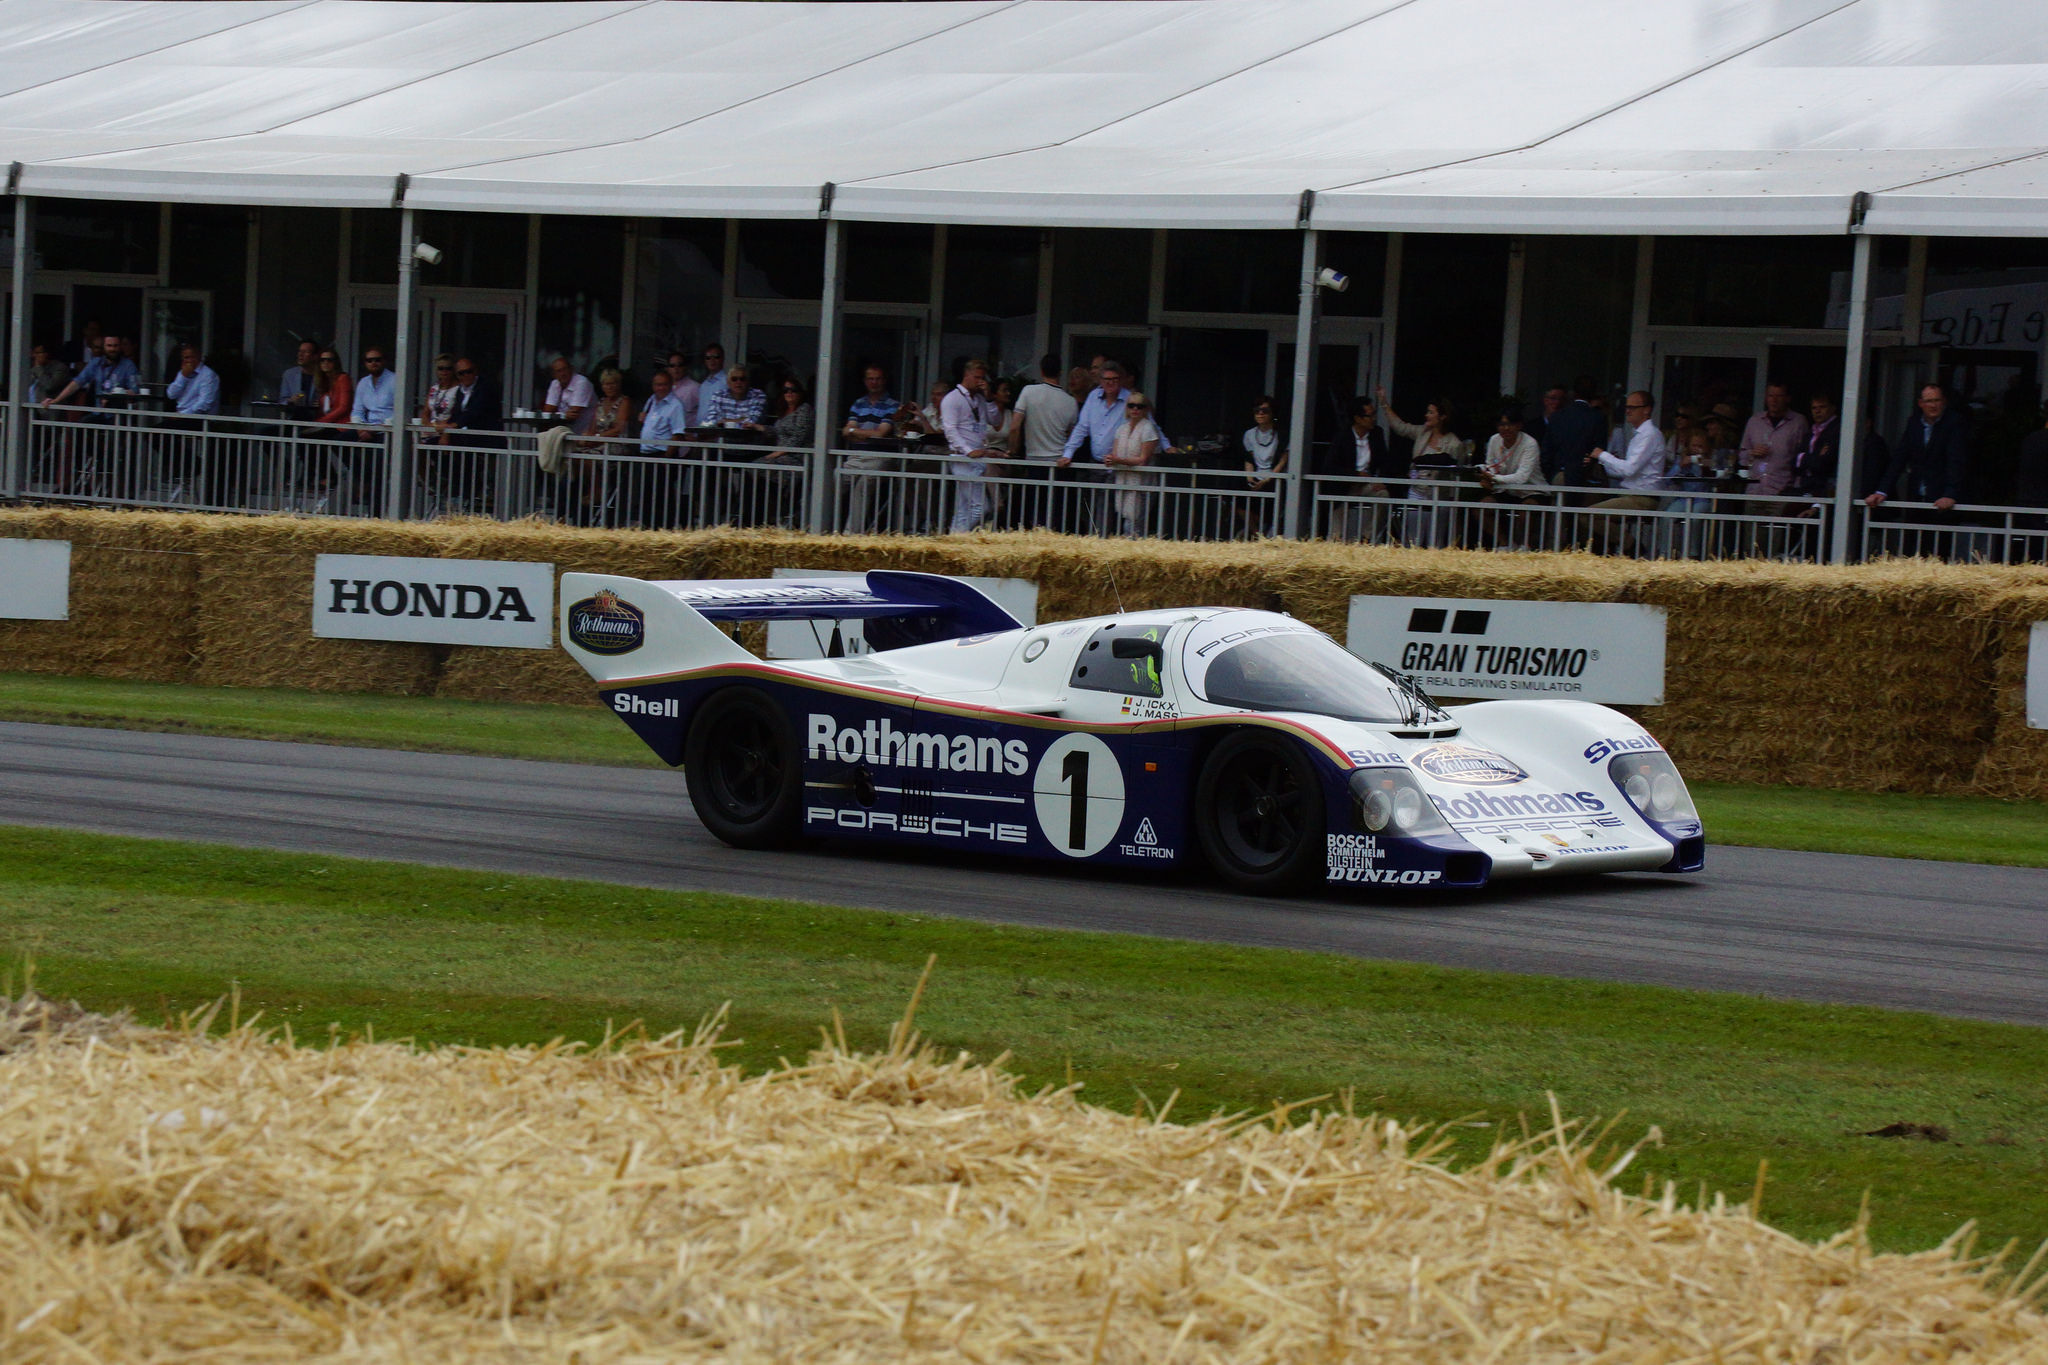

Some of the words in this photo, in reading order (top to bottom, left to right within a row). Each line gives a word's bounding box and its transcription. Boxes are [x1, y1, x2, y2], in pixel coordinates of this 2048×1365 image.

[328, 579, 536, 622] HONDA
[678, 587, 867, 600] othmans
[576, 612, 637, 638] Rothmans
[1196, 626, 1312, 657] PORSC
[1401, 642, 1468, 672] GRAN
[1475, 645, 1588, 678] TURISMO
[1426, 676, 1456, 687] REAL
[1459, 678, 1506, 690] DRIVING
[1510, 680, 1582, 692] SIMULATOR
[614, 692, 679, 718] Shell
[807, 713, 1029, 776] Rothmans
[1347, 749, 1405, 765] She
[1583, 735, 1659, 764] Shell
[1061, 750, 1090, 851] 1
[1428, 789, 1605, 820] Rothmans
[807, 806, 1028, 844] PORSCHE
[1455, 816, 1625, 835] PORSCHE
[1120, 844, 1174, 859] TELETRON
[1327, 834, 1376, 849] BOSCH
[1556, 845, 1630, 855] DUNLOP
[1327, 856, 1373, 869] BILSTEIN
[1326, 867, 1442, 885] DUNLOP
